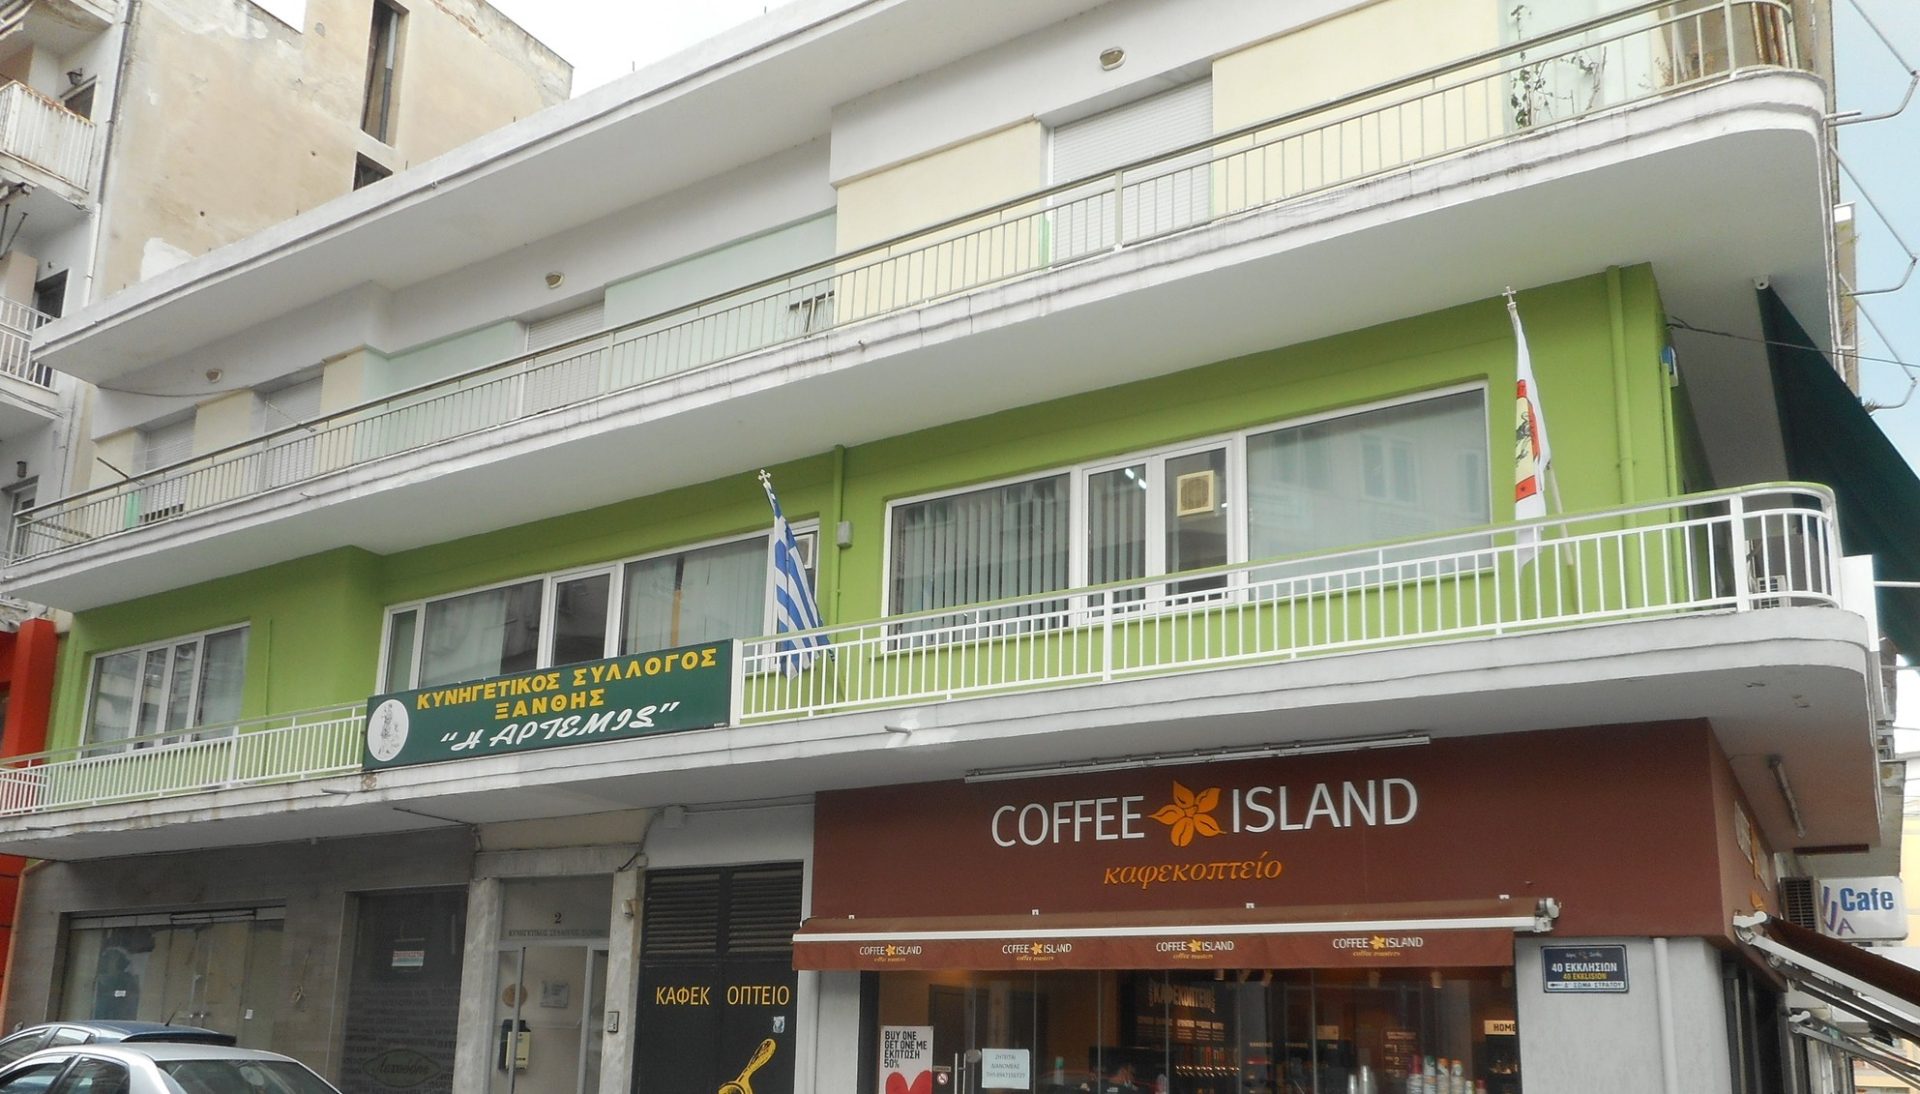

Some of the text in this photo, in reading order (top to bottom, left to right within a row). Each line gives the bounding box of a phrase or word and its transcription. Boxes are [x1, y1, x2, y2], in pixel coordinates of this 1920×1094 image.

[417, 647, 717, 710] ΚΥΝΗΓΕΤΙΚΟΣ ΣΥΛΛΟΓΟΣ
[494, 688, 605, 720] ΞΑΝΘΗΣ
[991, 778, 1418, 847] COFFEE ISLAND
[1104, 852, 1283, 887] καφεκοπτείο
[1840, 887, 1894, 912] Cafe
[553, 912, 562, 924] 2
[1002, 943, 1072, 954] COFFEE ISLAND
[1156, 940, 1234, 952] COFFEE ISLAND
[1332, 936, 1424, 949] COFFEE ISLAND
[859, 945, 922, 956] COFFEE ISLAND
[1551, 962, 1618, 972] 40 ΕΚΚΛΗΣΙΩΝ
[656, 985, 791, 1006] ΚΑΦΕΚ ΟΠΤΕΙΟ
[885, 1031, 917, 1040] BUY ONE
[884, 1041, 898, 1049] GET
[900, 1041, 915, 1050] ONE
[884, 1050, 920, 1059] ΕΚΠΤΩΣΗ
[884, 1059, 900, 1068] 50%
